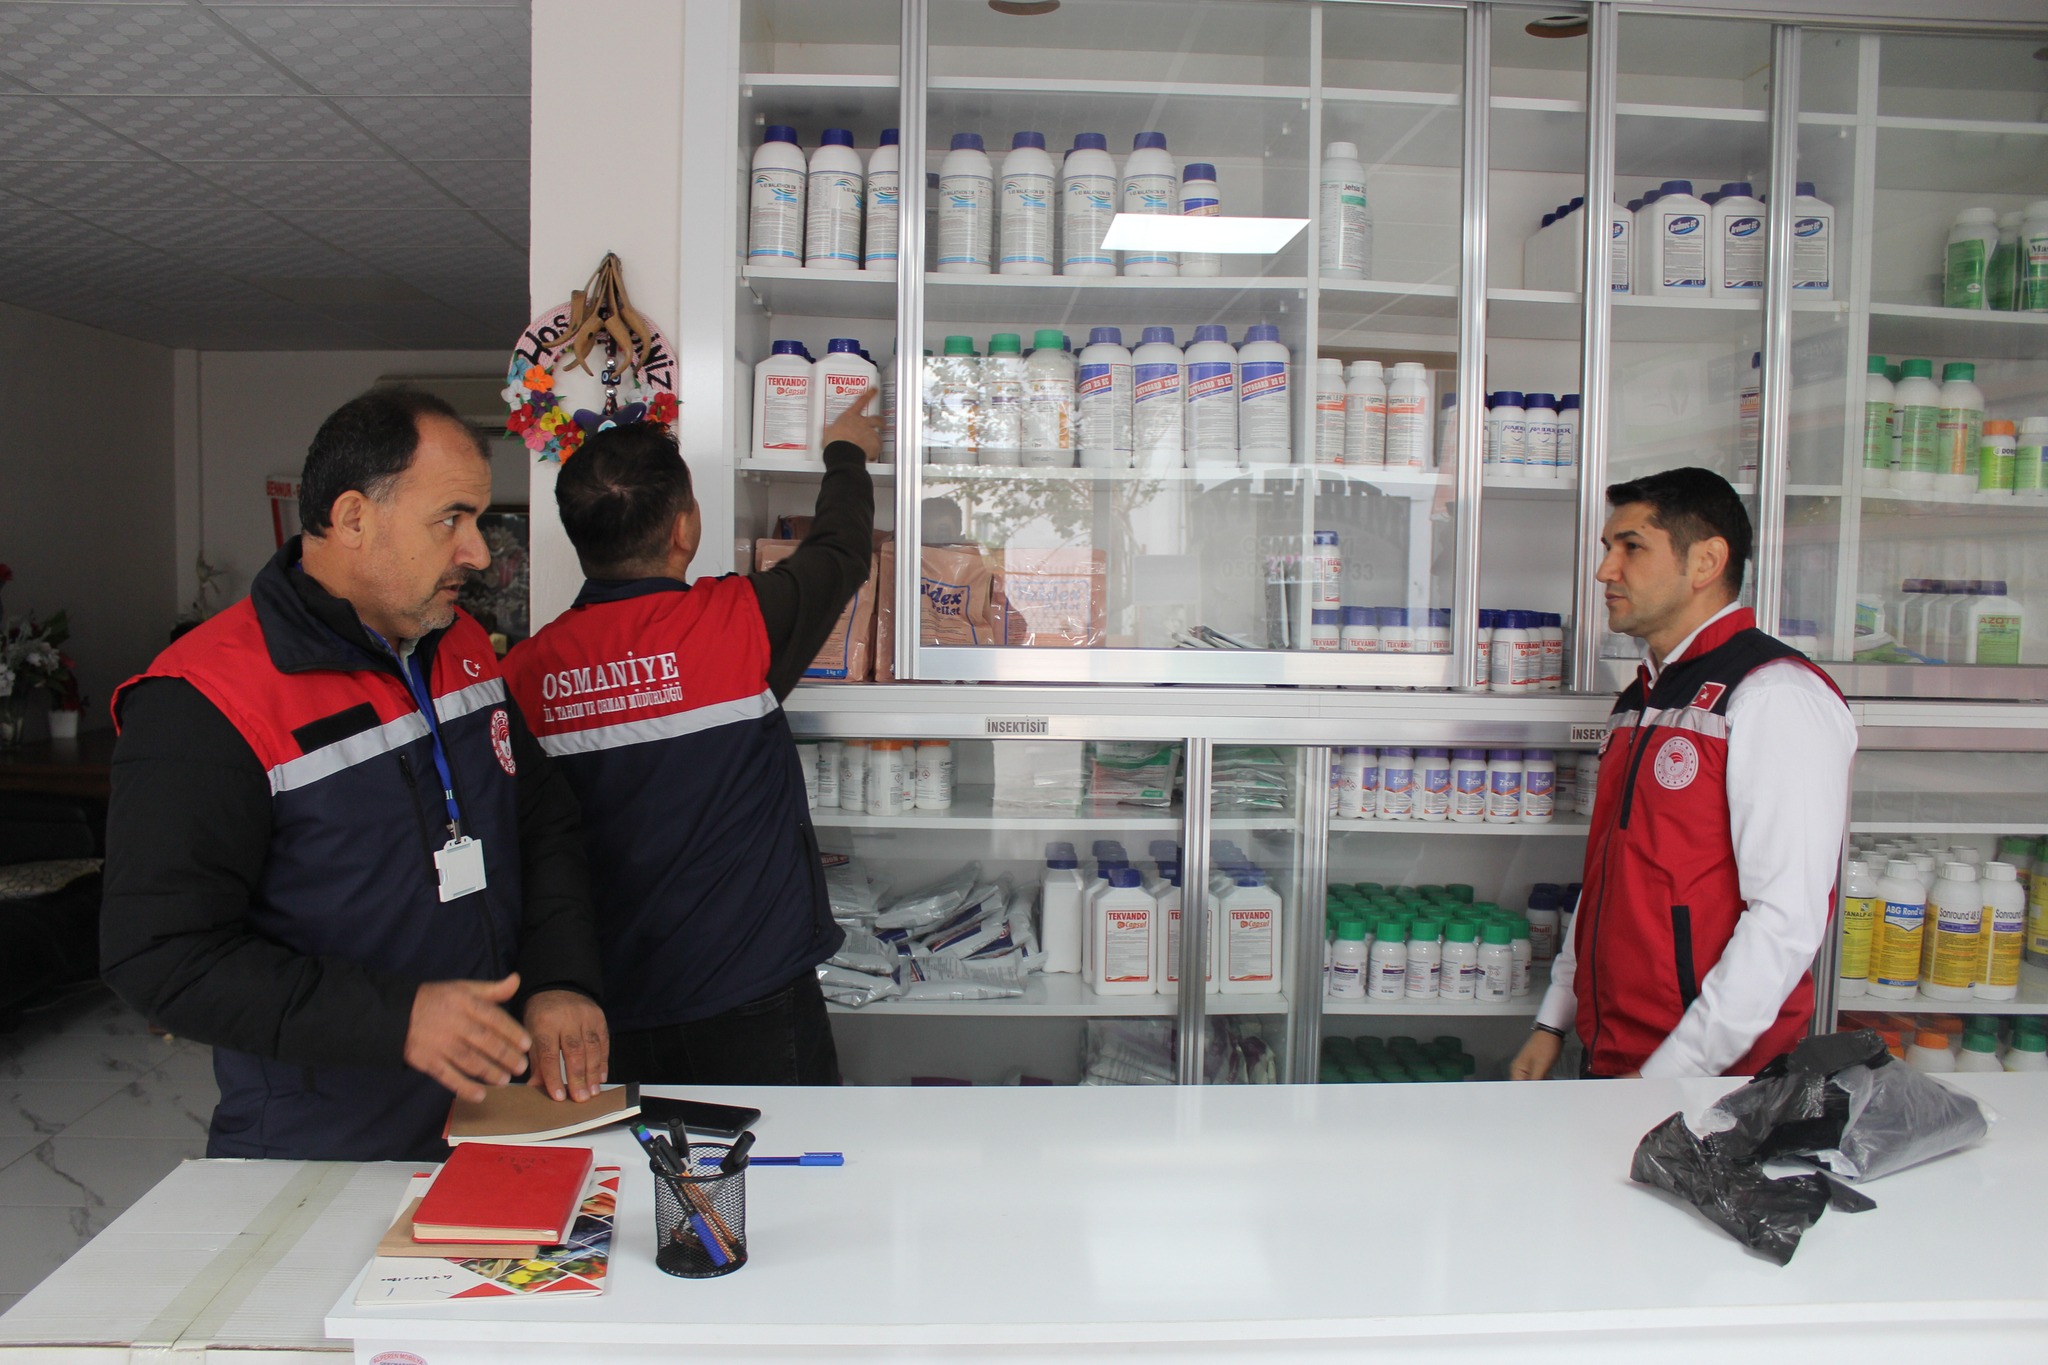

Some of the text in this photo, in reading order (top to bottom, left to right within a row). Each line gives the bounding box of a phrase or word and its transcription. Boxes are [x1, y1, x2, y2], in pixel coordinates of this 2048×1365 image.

[768, 377, 807, 387] TEKVANDO
[828, 376, 866, 387] TEKVANDO
[543, 651, 680, 700] OSMANİYE
[987, 719, 1047, 733] İNSEKTİSİT
[1886, 905, 1901, 915] ABG
[1108, 912, 1147, 922] TEKVANDO
[1231, 911, 1270, 921] TEKVANDO
